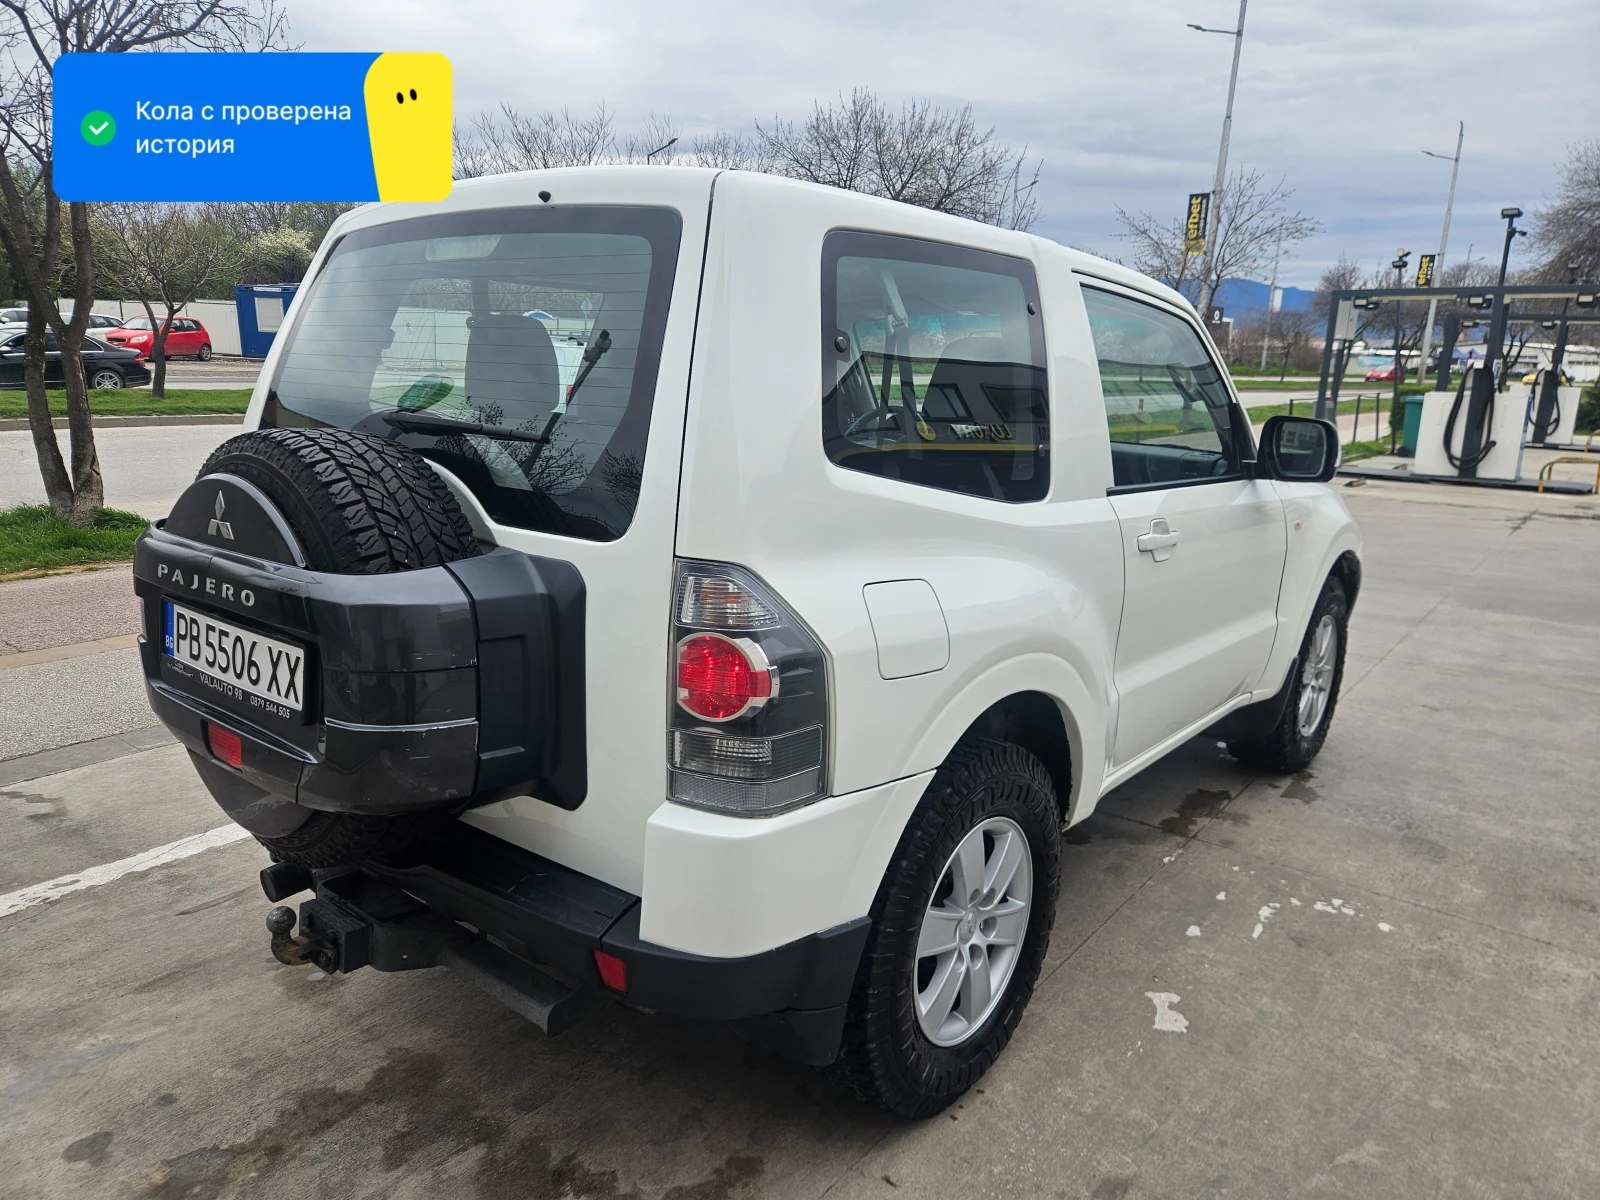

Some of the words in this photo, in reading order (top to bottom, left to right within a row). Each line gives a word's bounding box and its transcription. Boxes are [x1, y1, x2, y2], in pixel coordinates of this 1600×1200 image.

[1187, 195, 1202, 239] efbet
[1417, 256, 1431, 285] efbet
[157, 563, 255, 607] PAJERO
[165, 634, 174, 649] BG
[176, 610, 201, 661] PB
[205, 622, 261, 686] 5506
[267, 645, 301, 704] XX
[199, 672, 233, 696] VALAUTO
[249, 695, 265, 709] 0879
[265, 702, 277, 715] 544
[278, 706, 291, 719] 505
